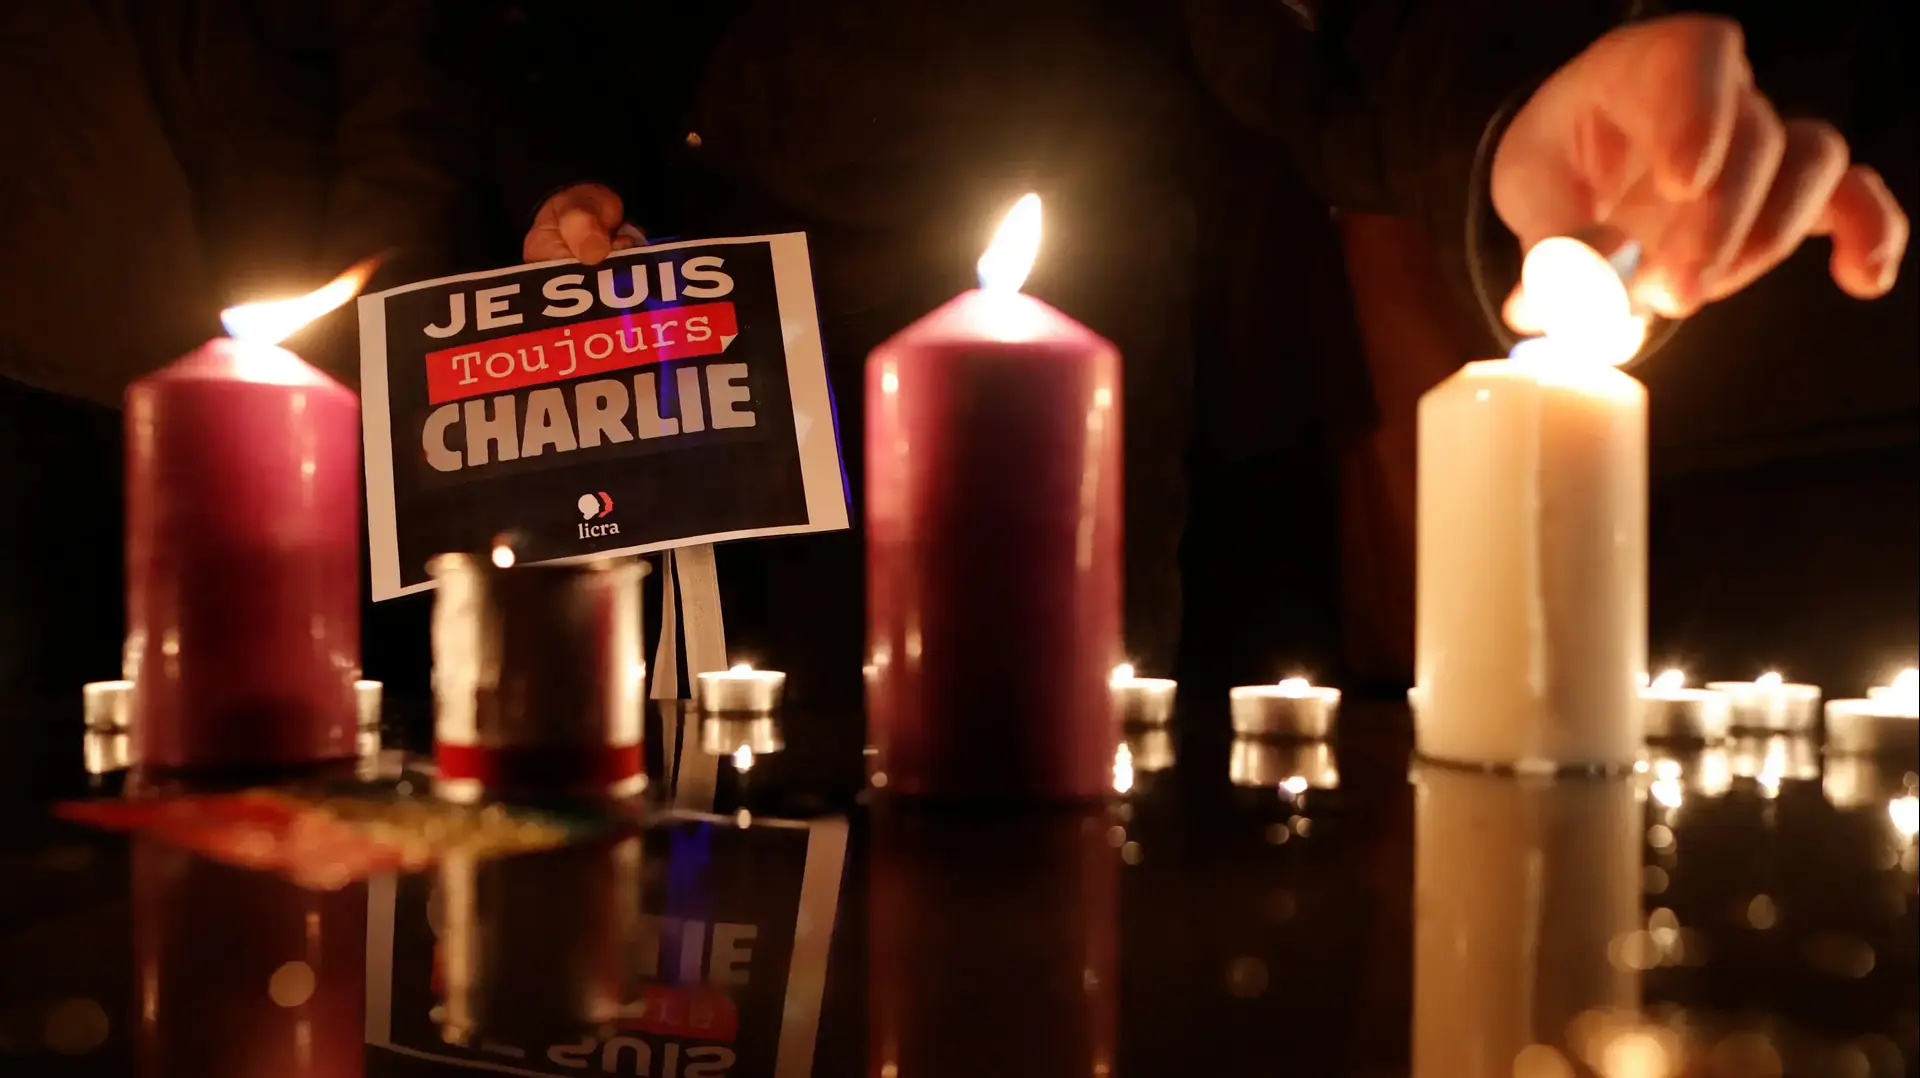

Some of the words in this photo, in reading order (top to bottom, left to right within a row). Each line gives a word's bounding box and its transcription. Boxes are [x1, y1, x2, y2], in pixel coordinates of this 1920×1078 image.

[423, 284, 524, 338] JE
[541, 256, 735, 318] SUIS
[451, 313, 714, 388] Toujours
[422, 362, 757, 472] CHARLIE
[578, 521, 621, 539] licra
